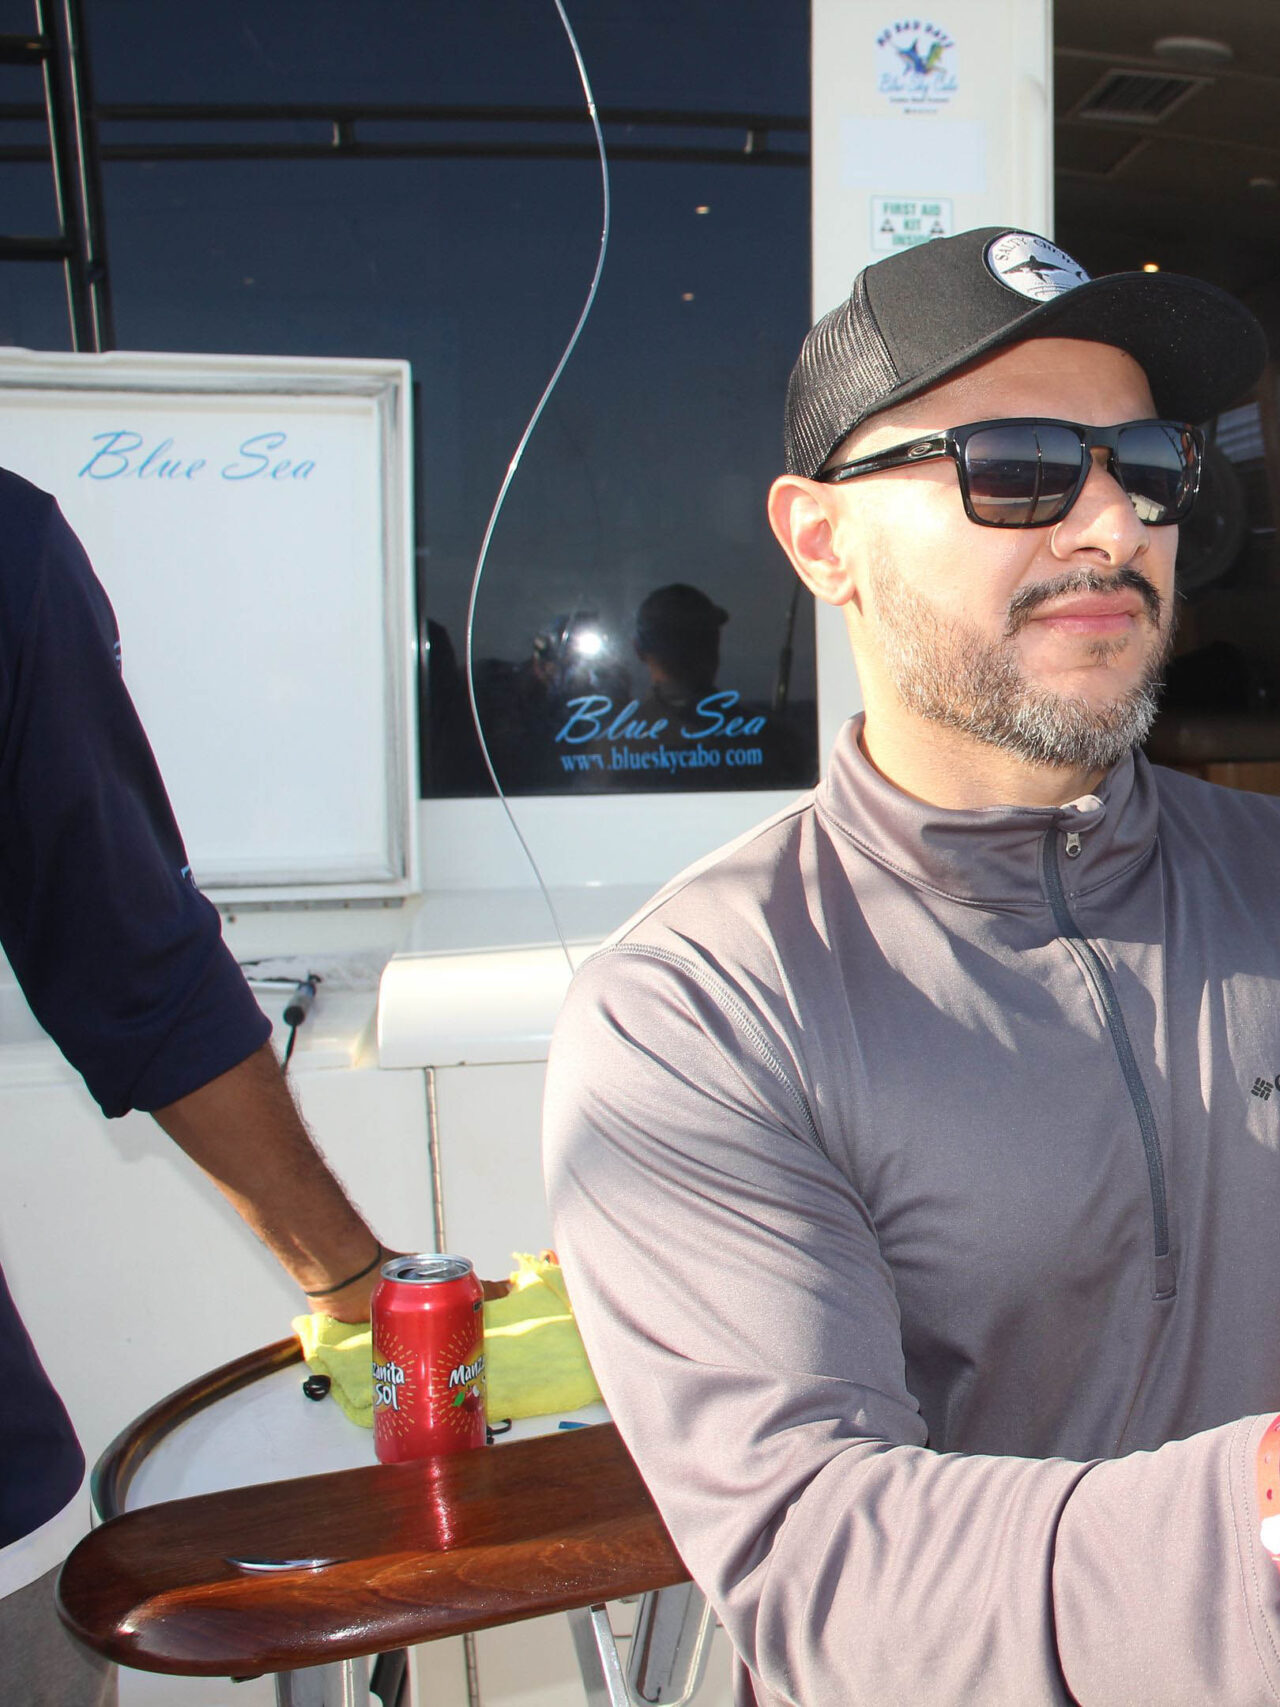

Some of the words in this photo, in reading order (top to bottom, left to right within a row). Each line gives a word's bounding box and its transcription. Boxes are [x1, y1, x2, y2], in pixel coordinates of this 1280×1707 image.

[882, 202, 916, 215] FIRST
[921, 203, 941, 216] AID
[904, 219, 920, 230] KIT
[995, 237, 1028, 261] SALTY
[78, 430, 206, 480] Blue
[221, 431, 316, 480] Sea
[555, 695, 669, 744] Blue
[681, 690, 767, 739] Sea
[560, 744, 763, 774] www.blueskycabocom
